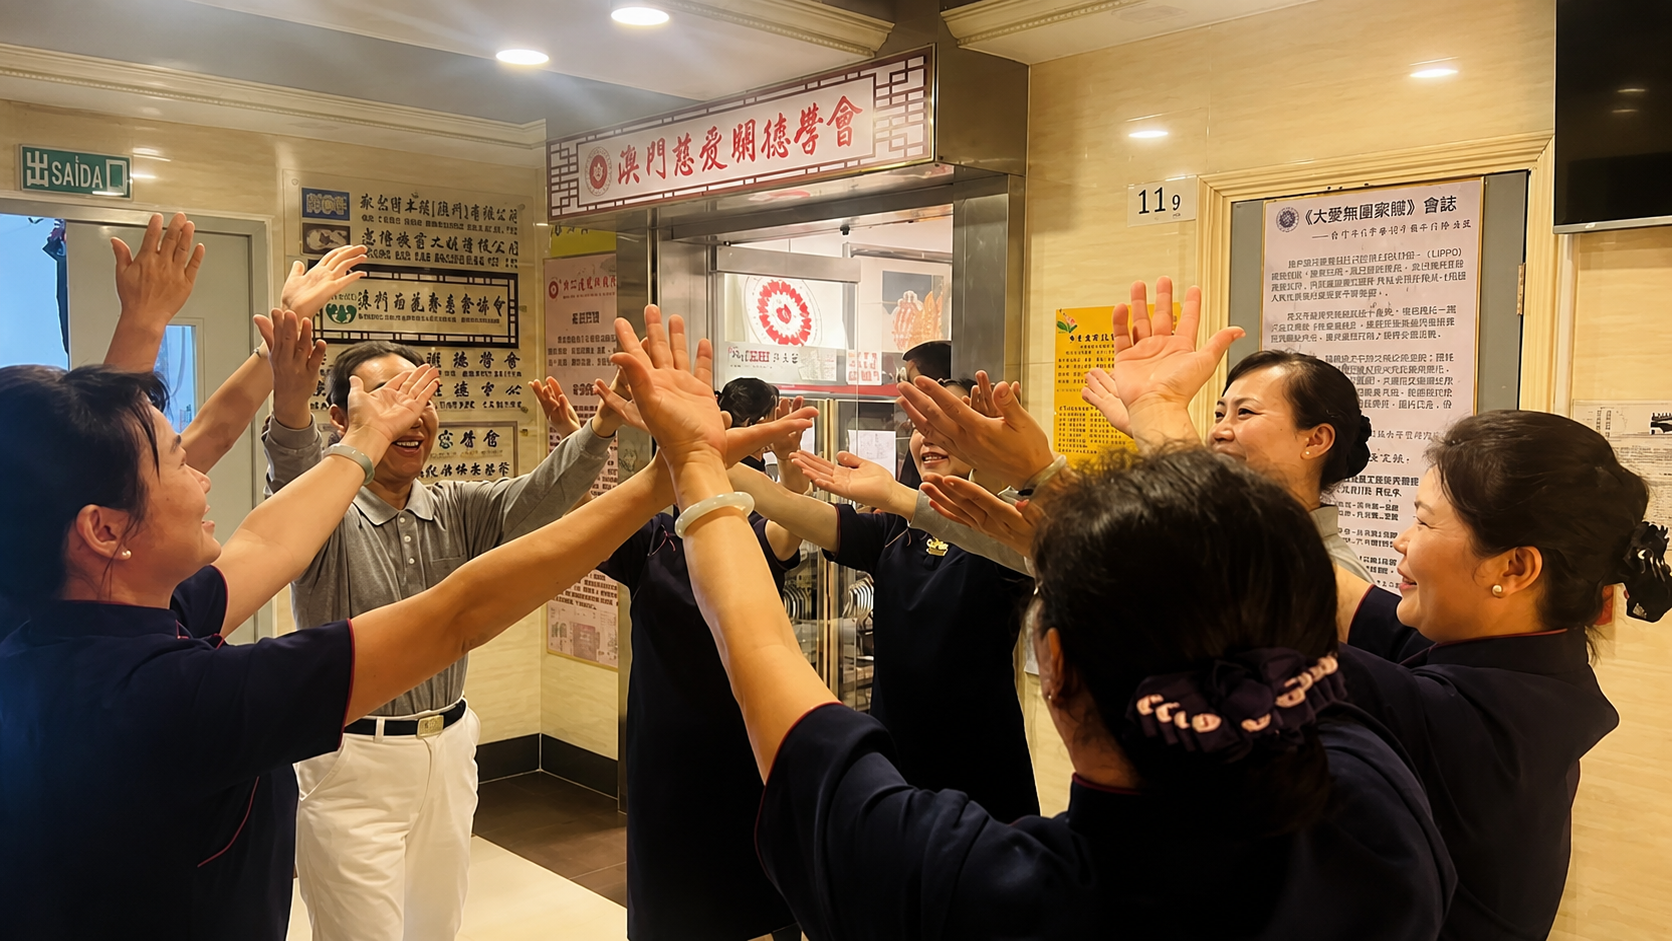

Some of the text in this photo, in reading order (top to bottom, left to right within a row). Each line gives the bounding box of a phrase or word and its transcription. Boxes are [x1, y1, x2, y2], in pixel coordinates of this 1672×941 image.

[26, 150, 49, 188] 出
[51, 155, 103, 189] SAÍDA
[1138, 186, 1166, 215] 11
[1423, 194, 1458, 214] 會誌
